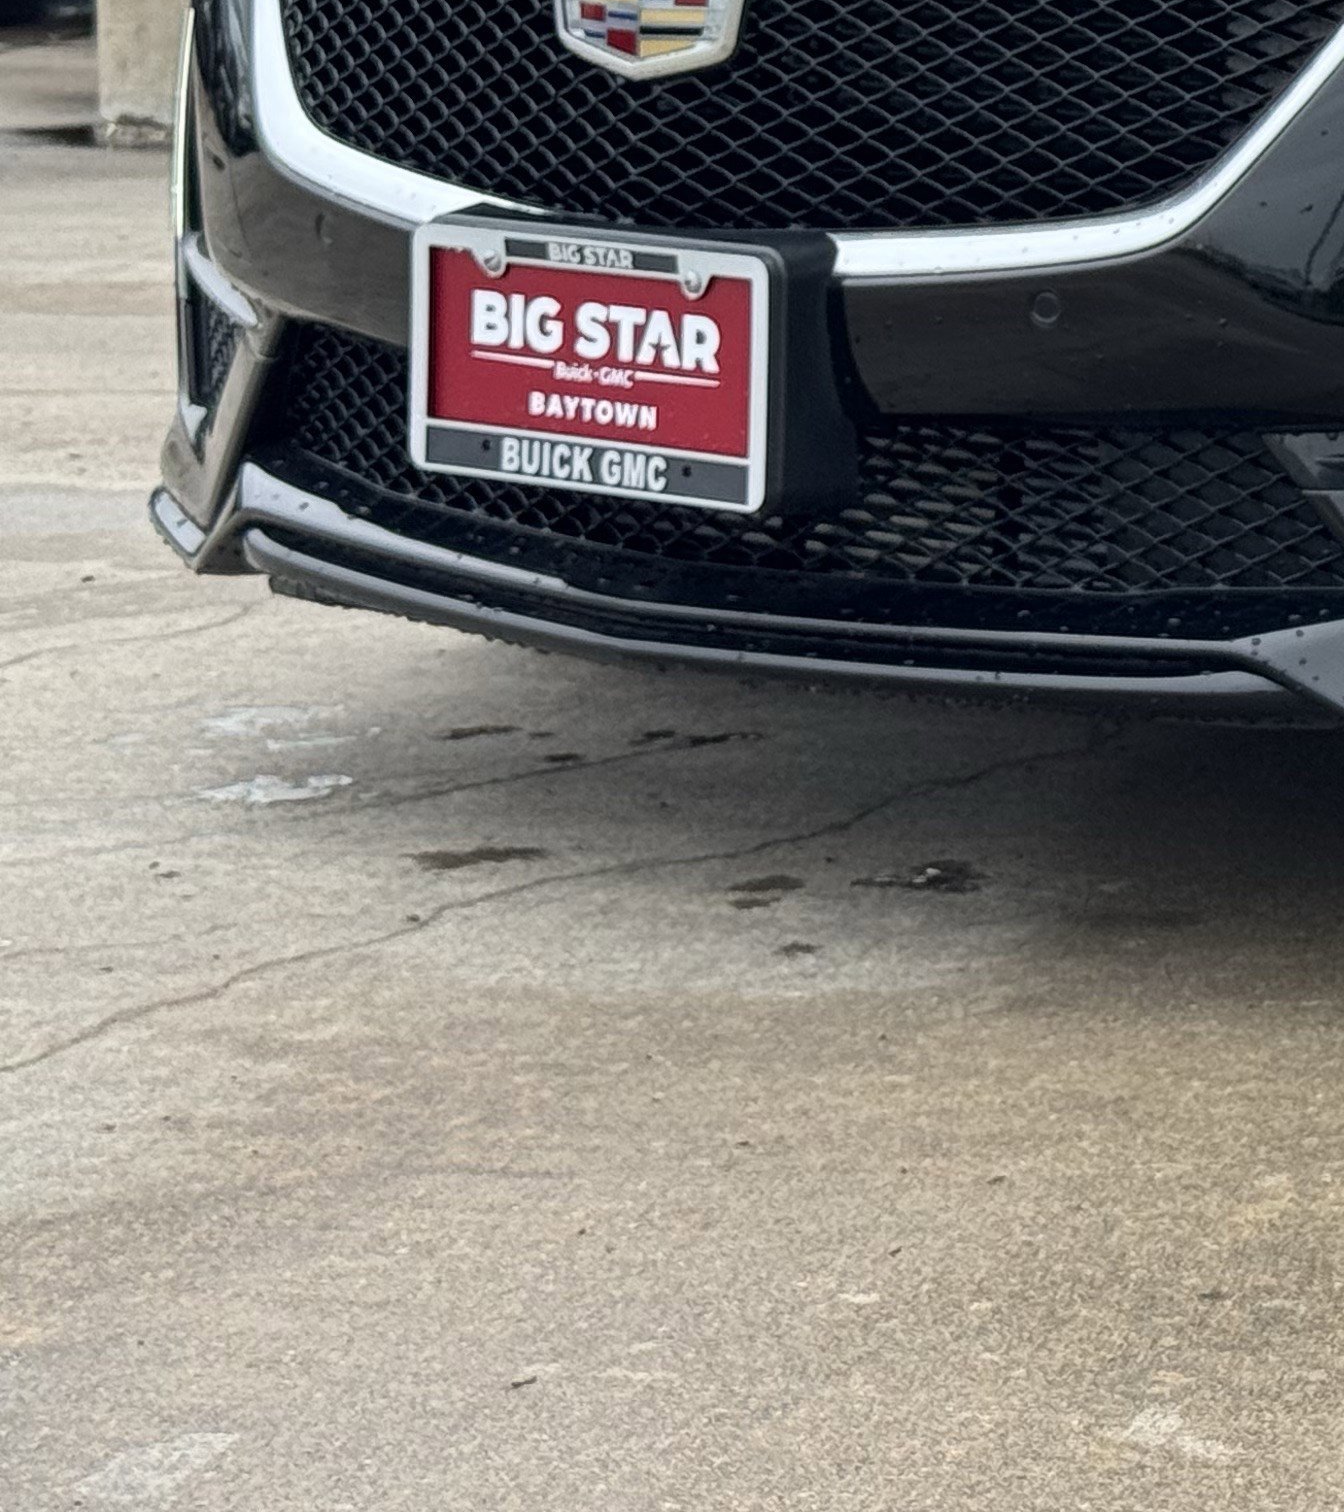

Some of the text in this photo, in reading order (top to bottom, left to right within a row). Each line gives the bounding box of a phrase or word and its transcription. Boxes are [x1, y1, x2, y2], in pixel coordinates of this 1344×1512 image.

[549, 242, 634, 268] BIG STAR
[470, 289, 721, 374] BIG STAR
[597, 366, 635, 389] GMC
[528, 391, 658, 431] BAYTOWN
[501, 437, 668, 492] BUICK GMC
